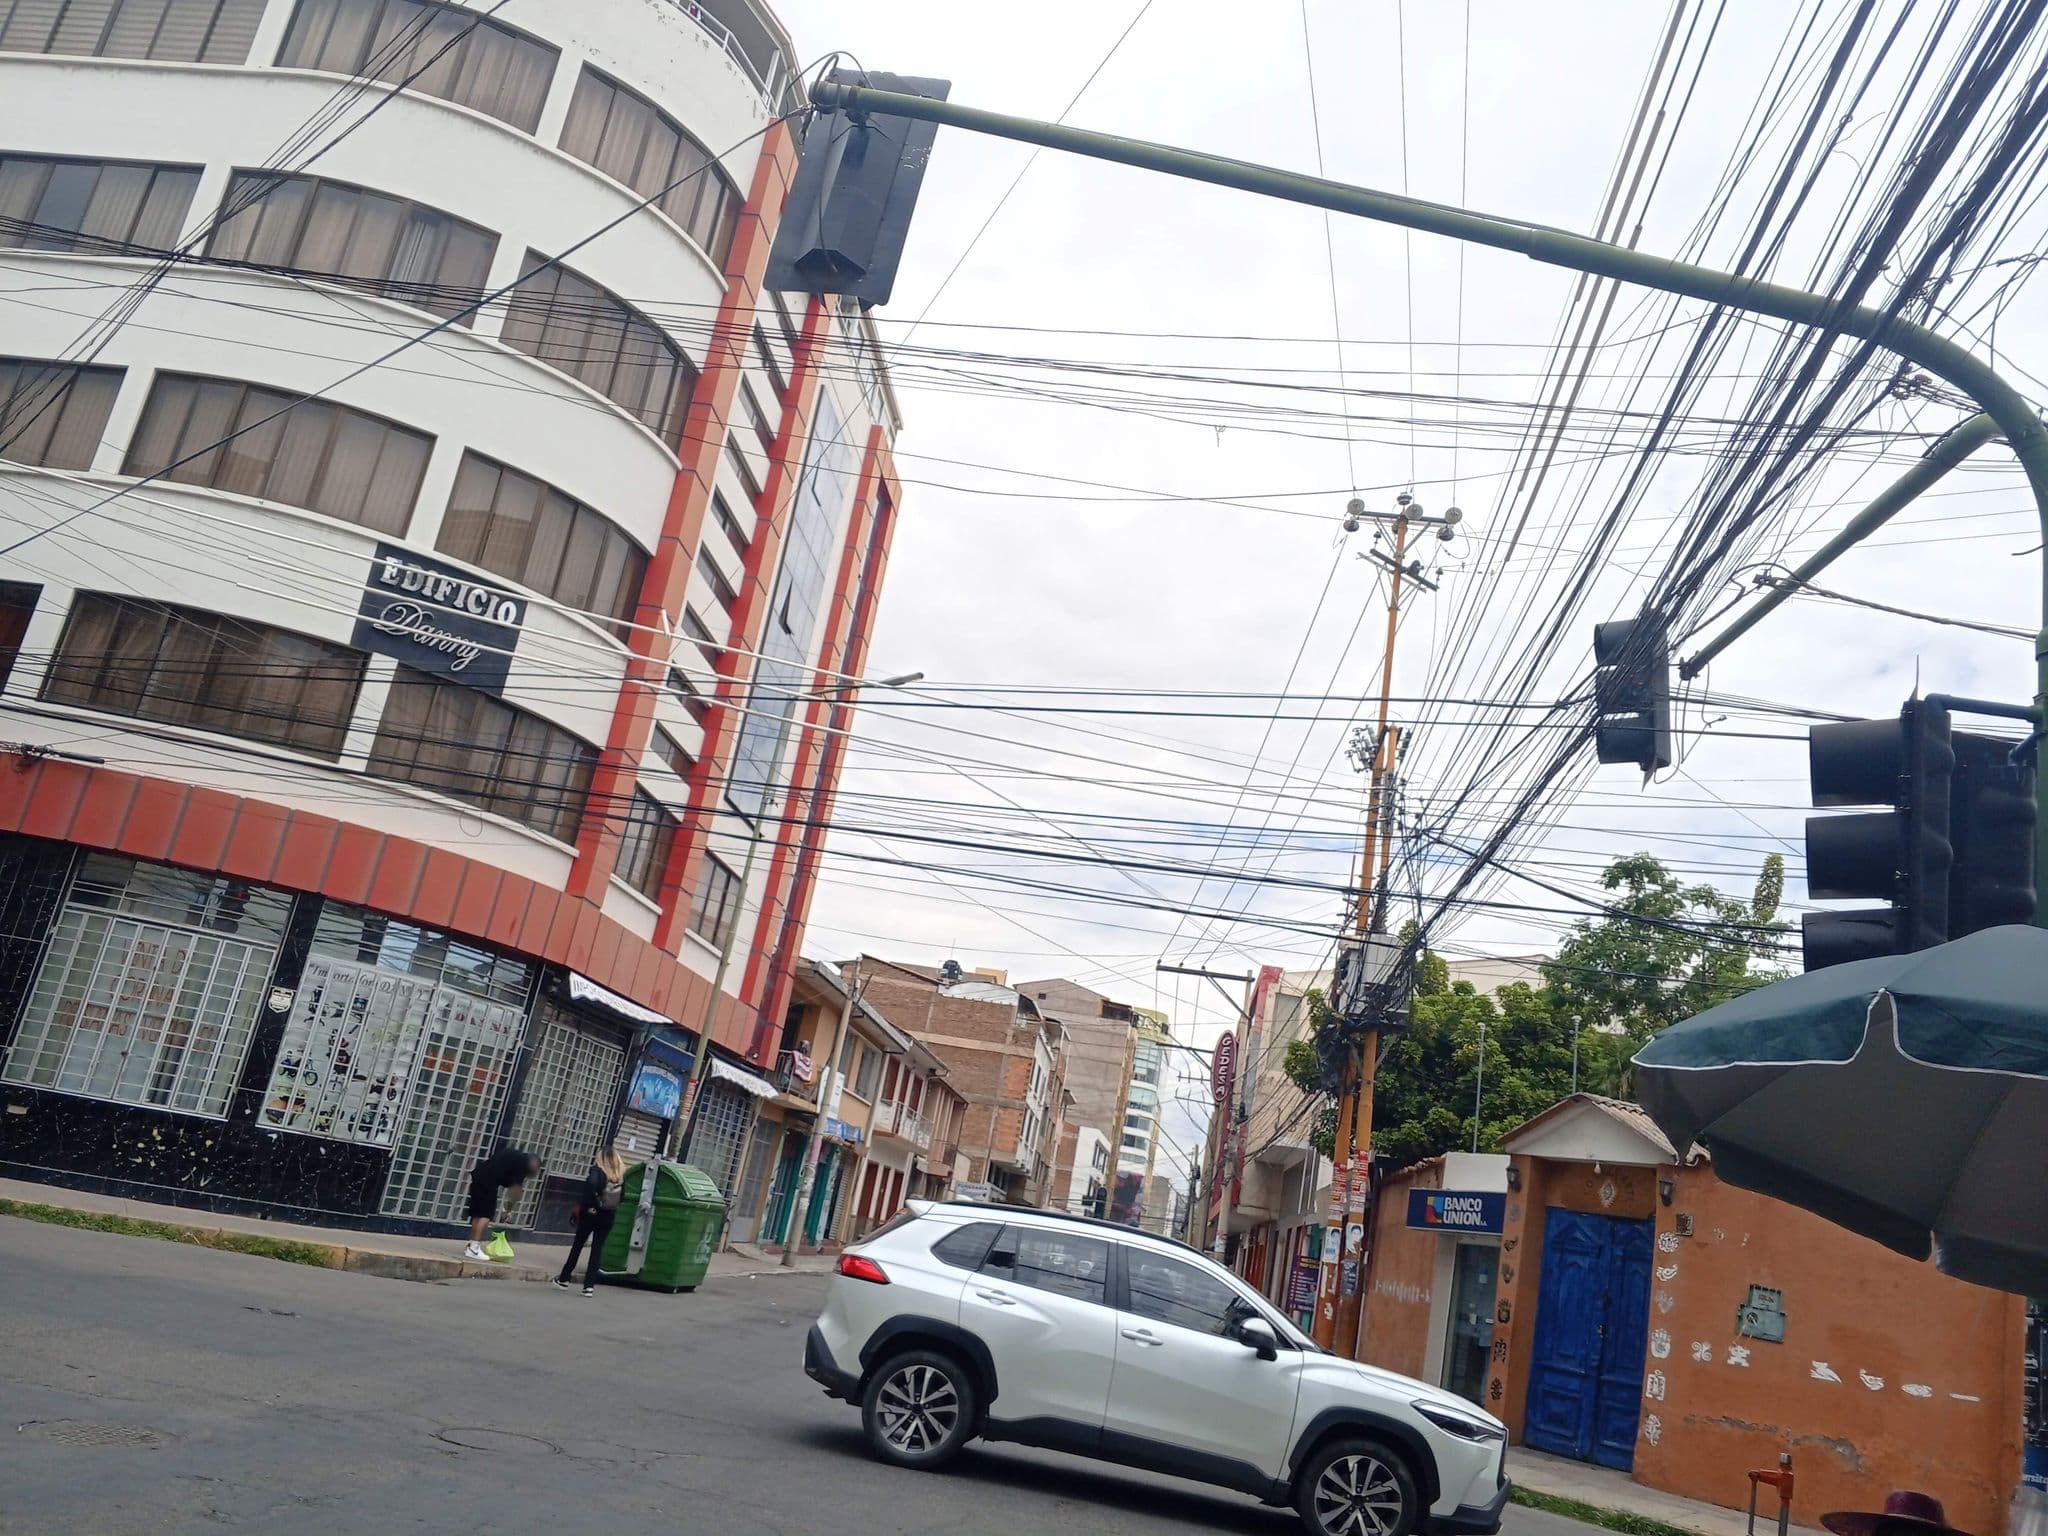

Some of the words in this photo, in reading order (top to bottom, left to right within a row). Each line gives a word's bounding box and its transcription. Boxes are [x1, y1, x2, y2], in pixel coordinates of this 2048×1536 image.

[380, 556, 518, 625] EDIFICIO
[373, 602, 481, 671] Danny
[1215, 1036, 1232, 1095] GEDESA
[1442, 1210, 1481, 1226] UNION
[1444, 1196, 1482, 1212] BANCO
